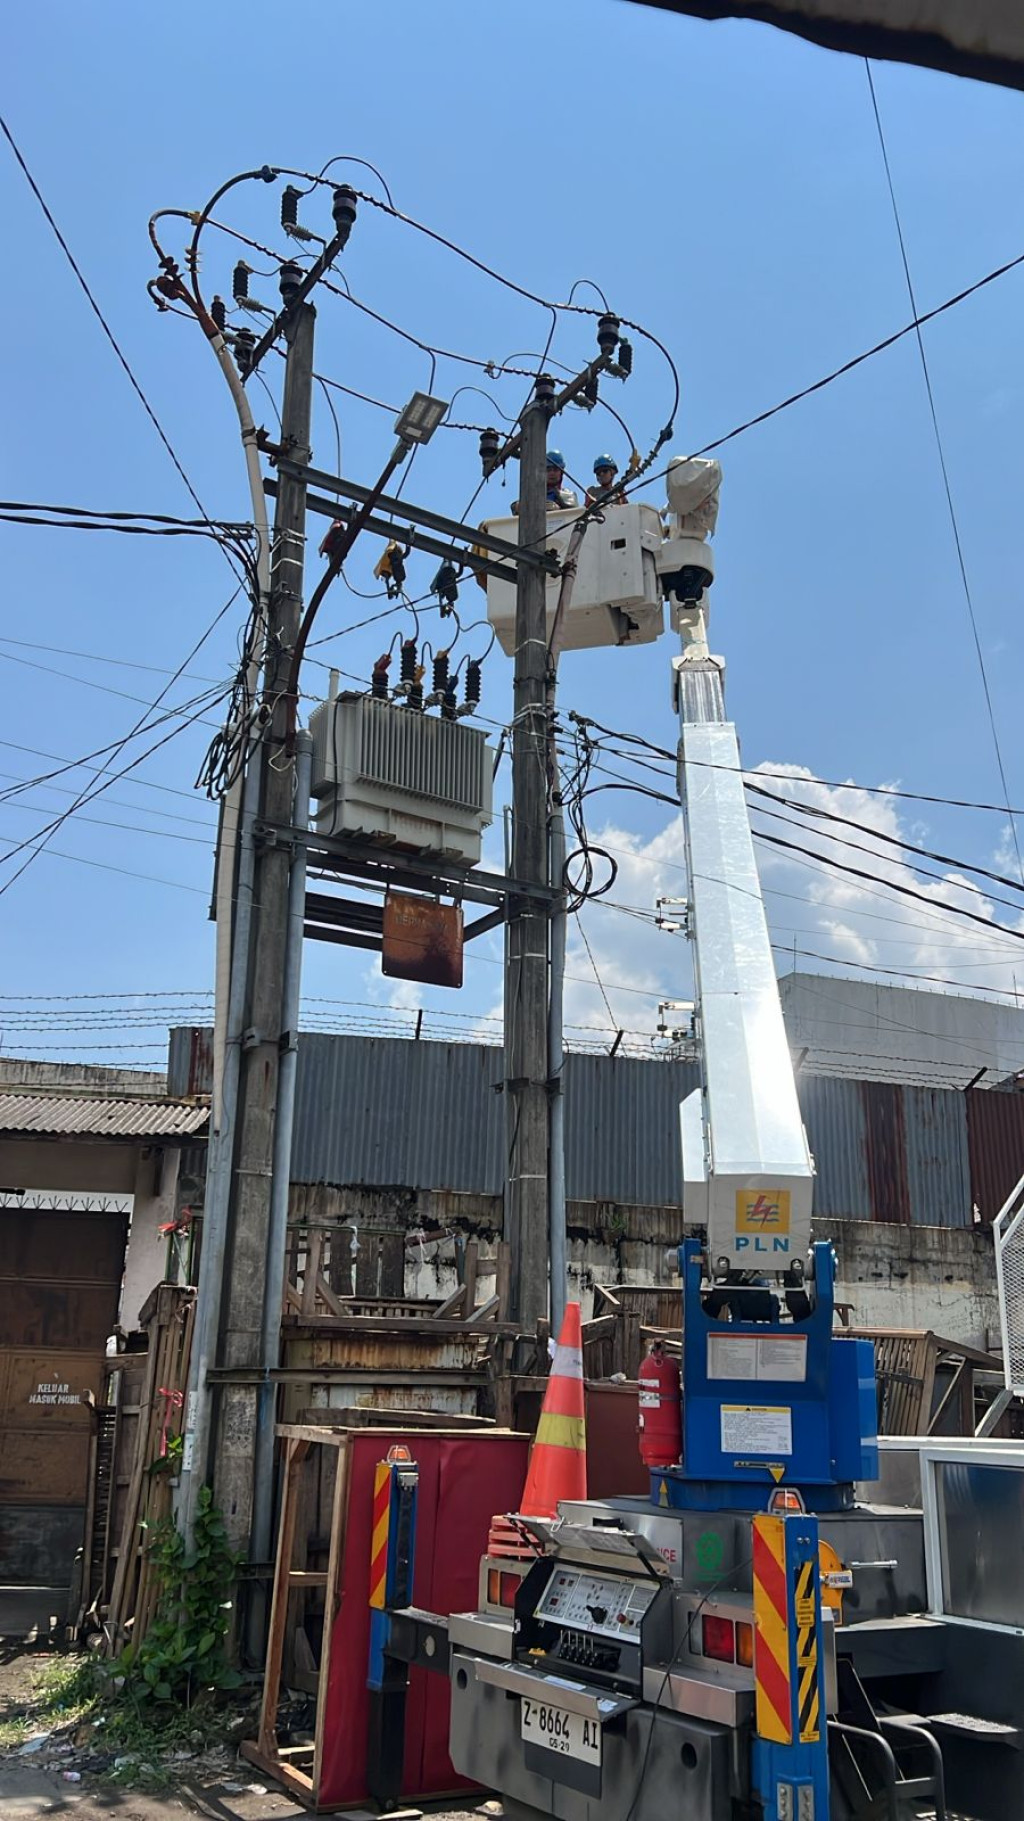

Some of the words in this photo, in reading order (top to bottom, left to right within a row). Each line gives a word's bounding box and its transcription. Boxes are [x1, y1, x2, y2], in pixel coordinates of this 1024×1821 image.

[735, 1237, 789, 1252] PLN
[37, 1383, 69, 1393] KELUAR
[28, 1394, 57, 1404] MASUK
[57, 1394, 81, 1405] MOBIL
